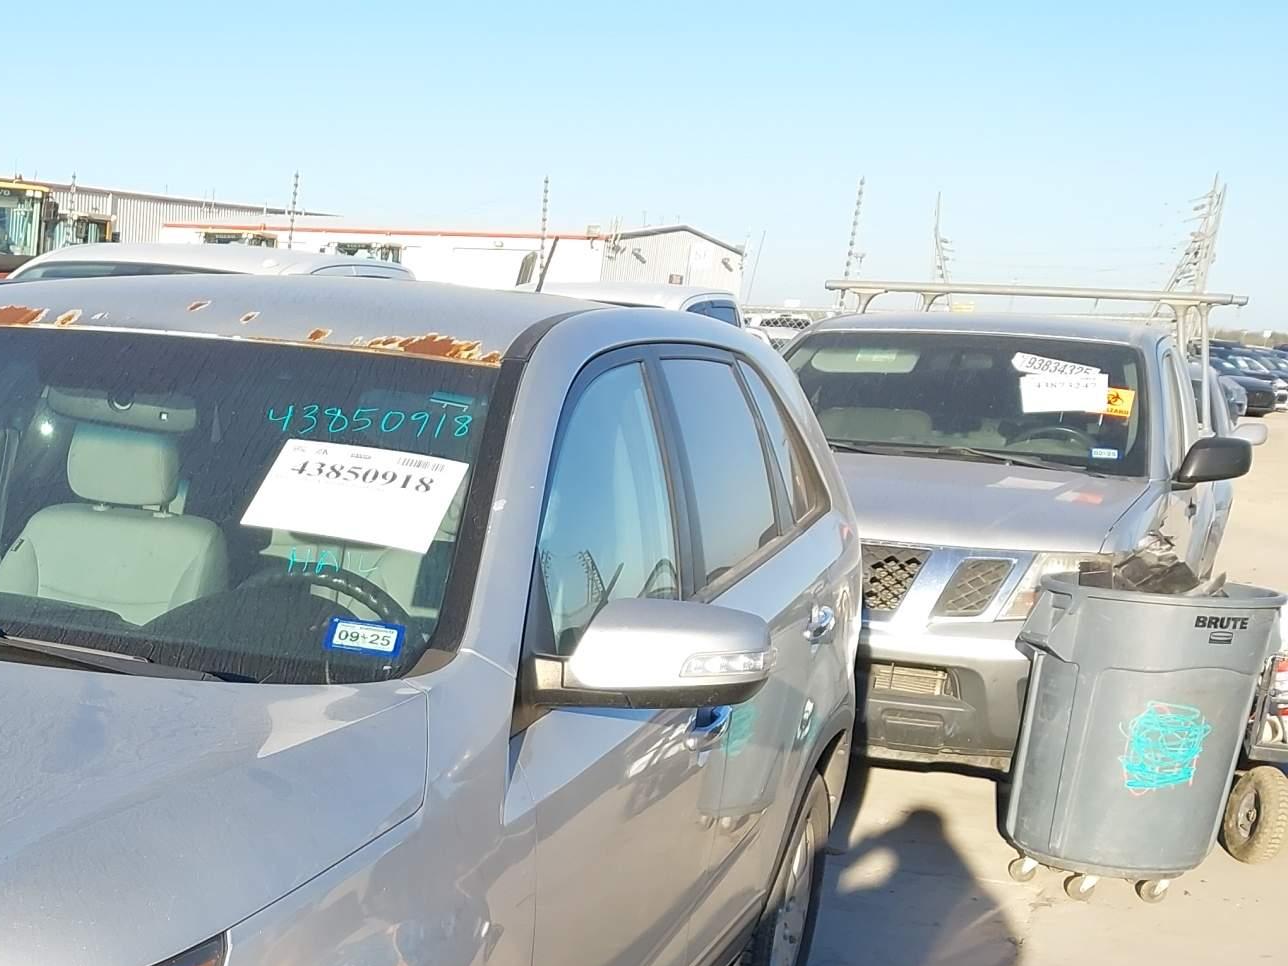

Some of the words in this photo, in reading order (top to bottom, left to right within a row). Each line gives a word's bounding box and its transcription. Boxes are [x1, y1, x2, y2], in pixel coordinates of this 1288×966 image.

[267, 405, 473, 438] 43850918
[291, 460, 435, 493] 43850918
[1194, 615, 1250, 630] BRUTE
